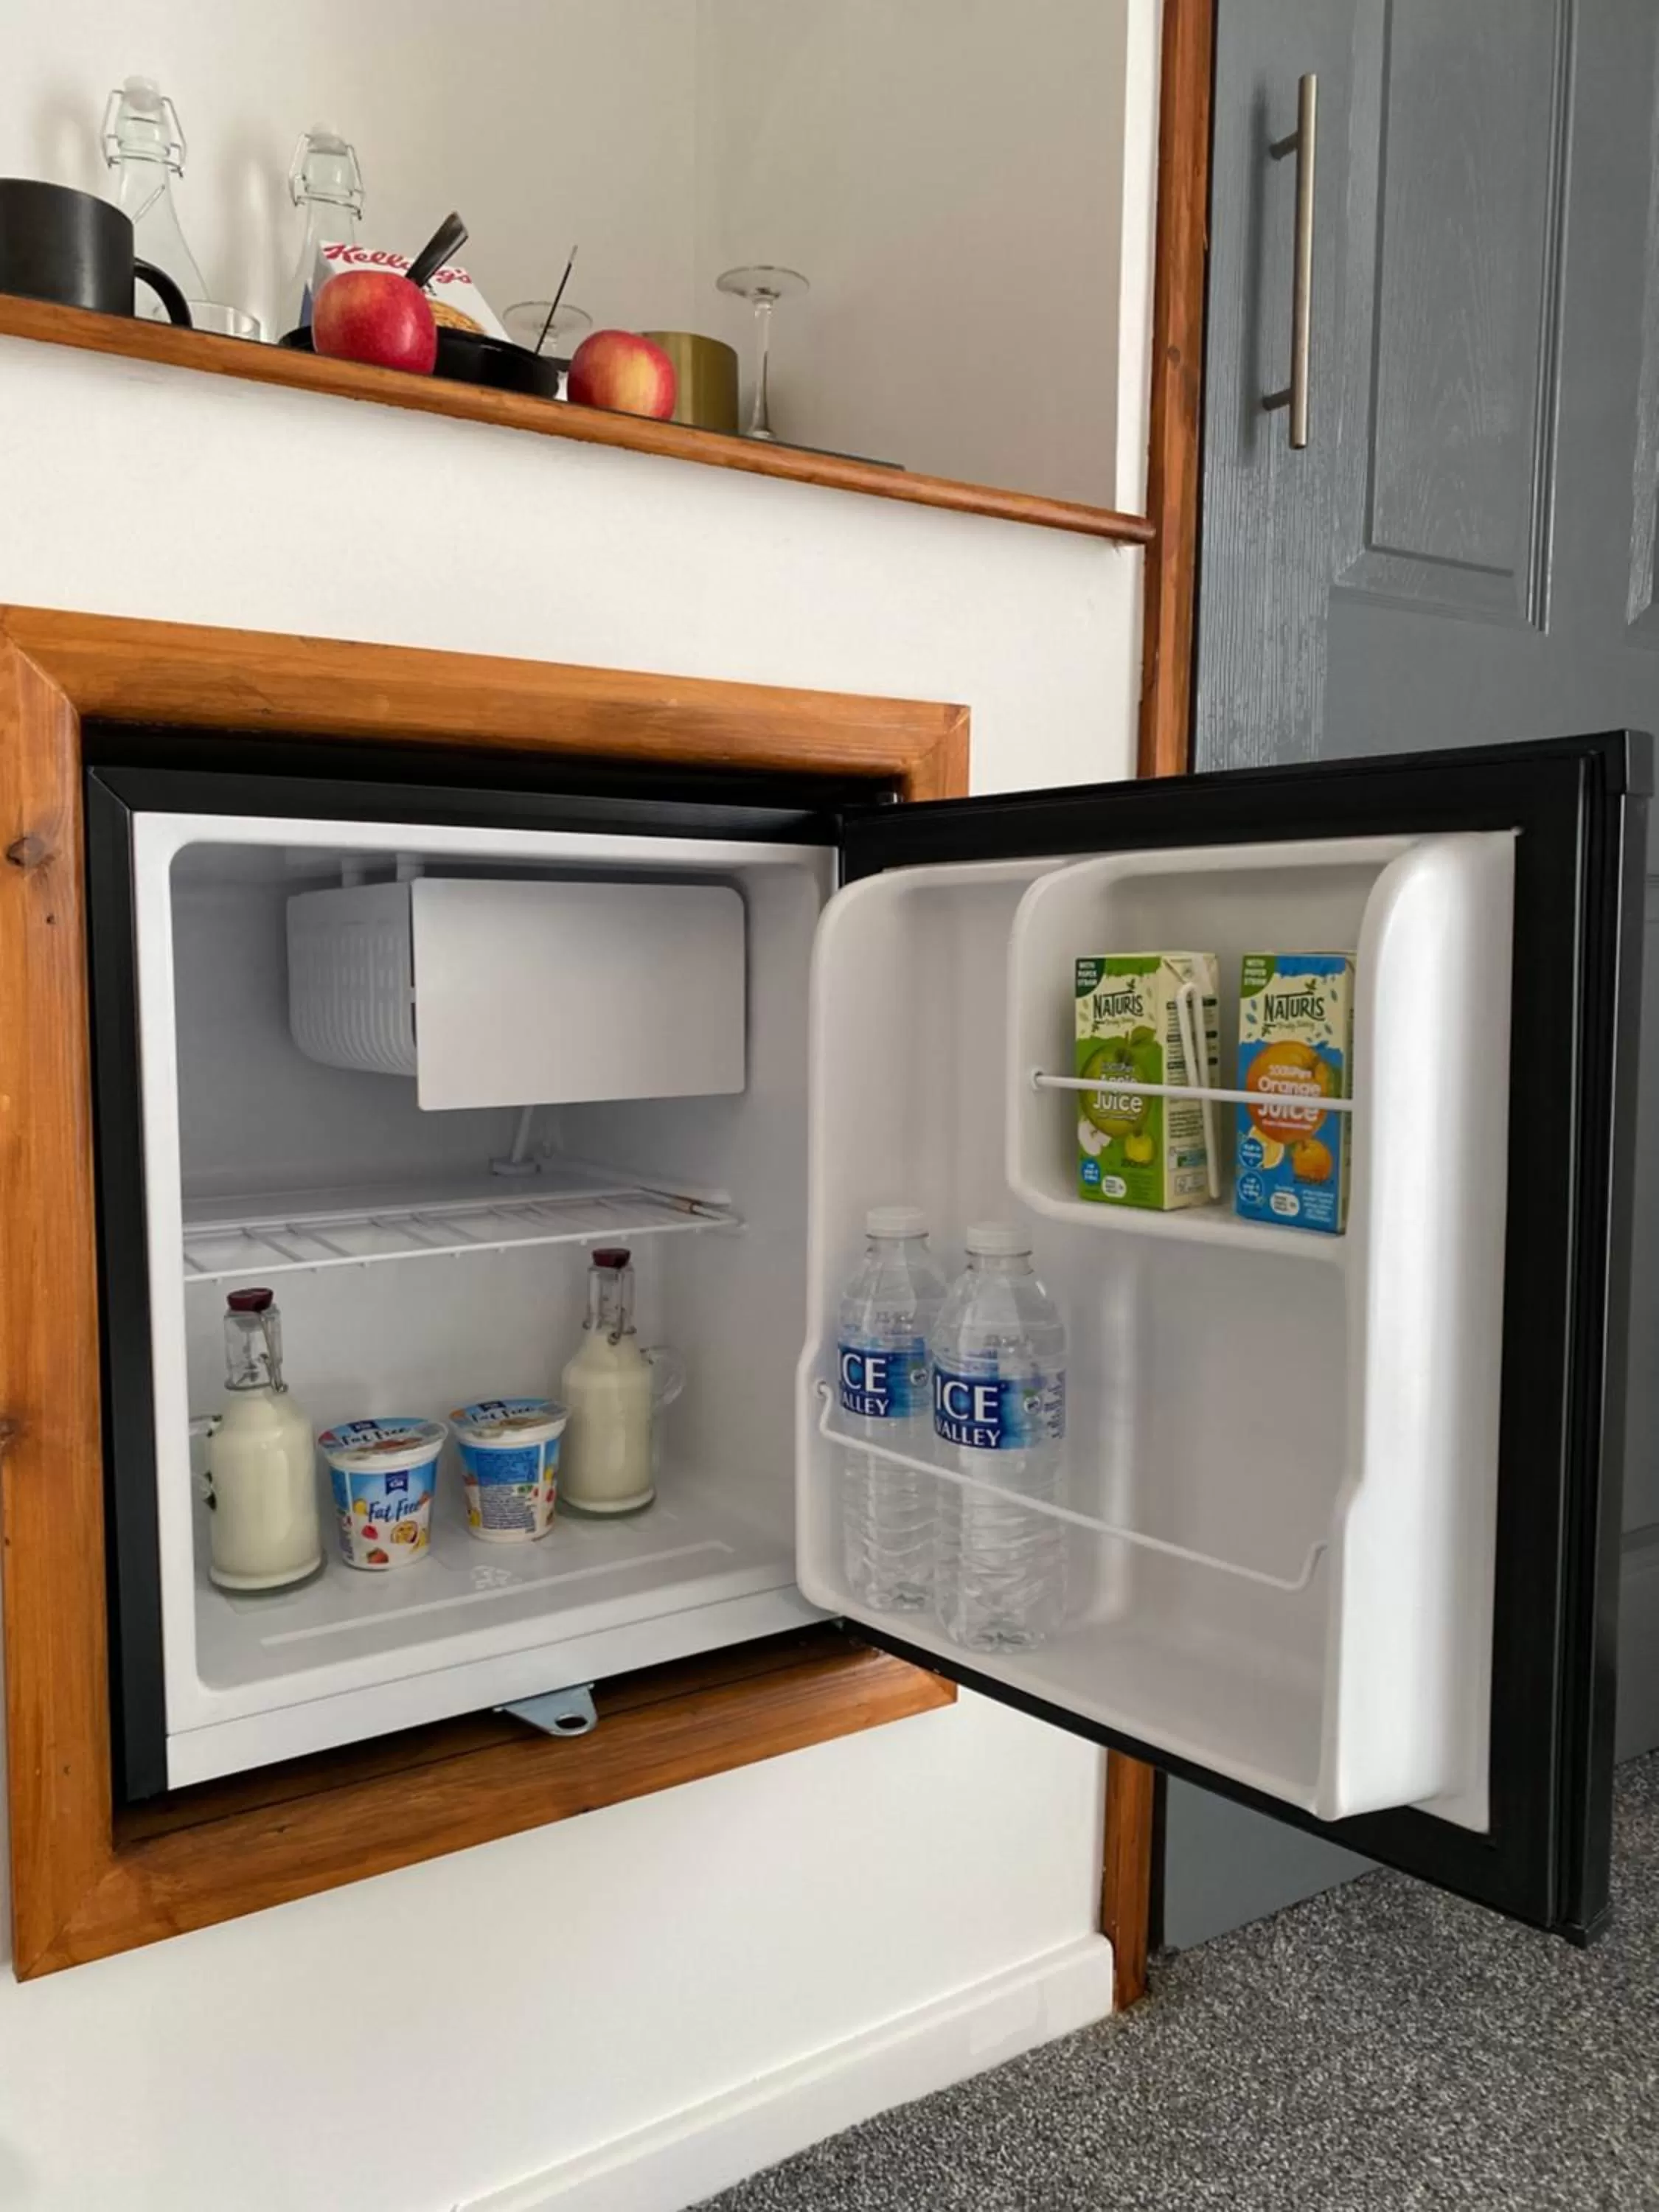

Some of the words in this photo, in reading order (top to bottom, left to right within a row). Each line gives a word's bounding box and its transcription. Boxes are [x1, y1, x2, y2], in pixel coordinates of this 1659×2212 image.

[324, 244, 472, 284] Kellg's
[1093, 990, 1144, 1019] NATURIS
[1264, 991, 1326, 1021] NATURIS
[1093, 1091, 1143, 1113] Juice
[840, 1391, 889, 1416] ALLEY
[936, 1375, 998, 1423] ICE
[369, 1500, 392, 1522] Fat
